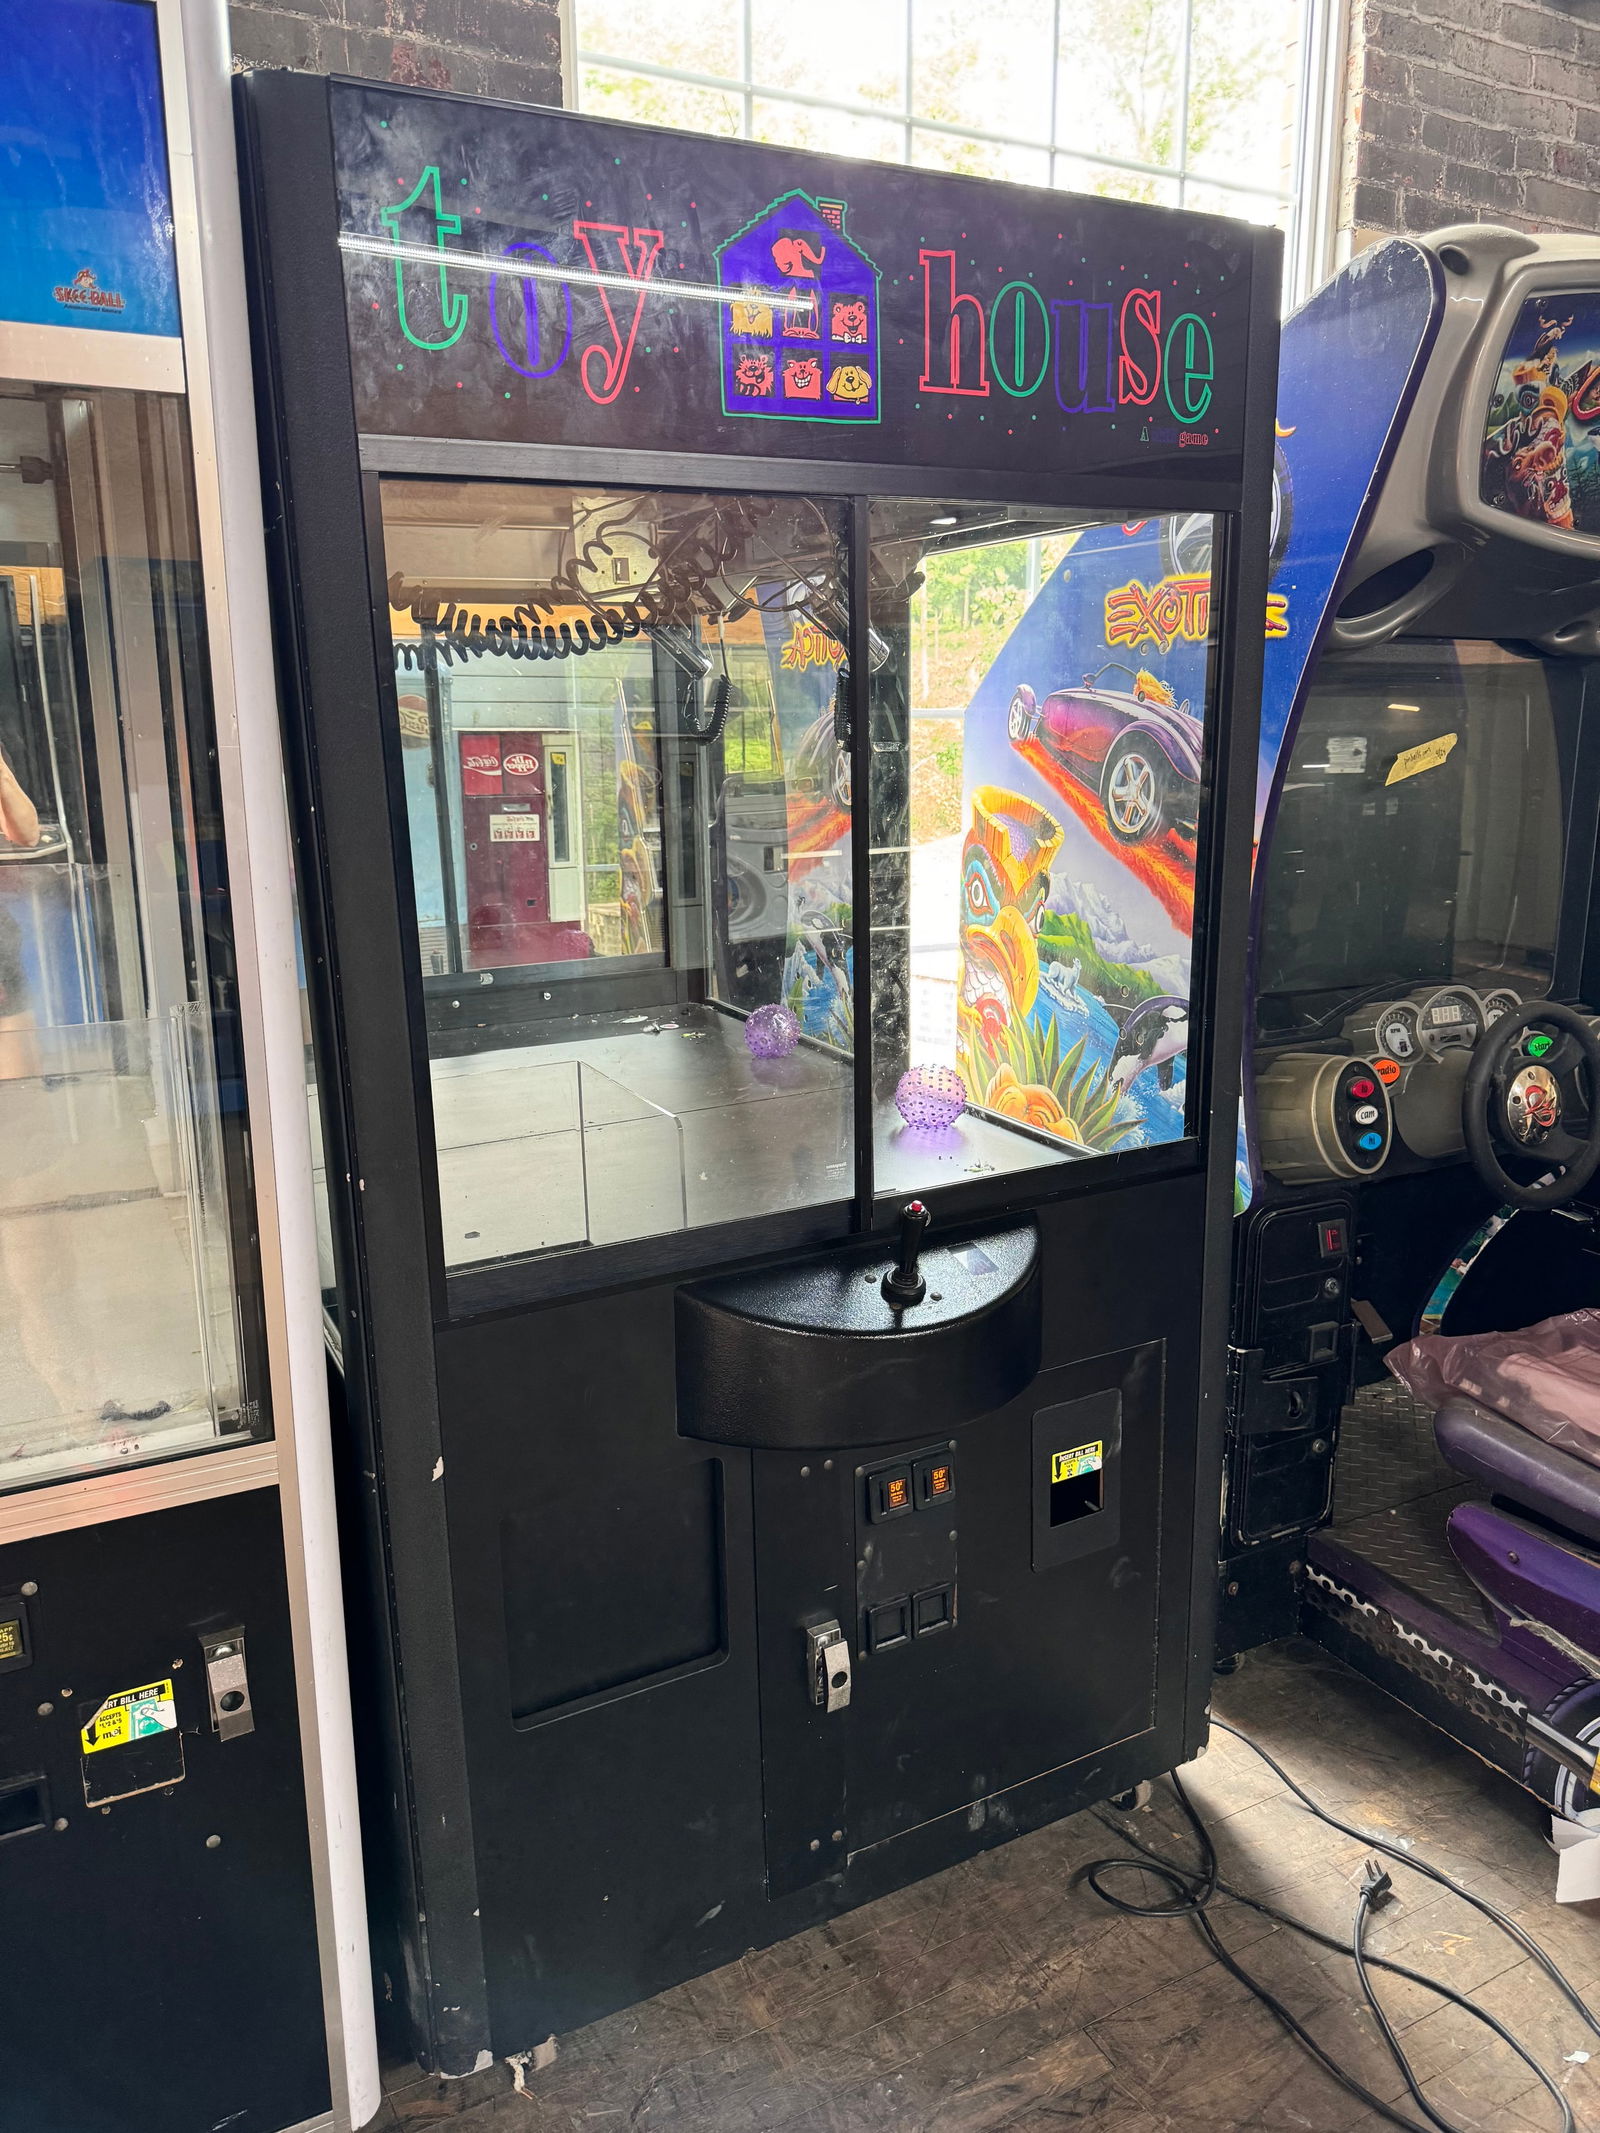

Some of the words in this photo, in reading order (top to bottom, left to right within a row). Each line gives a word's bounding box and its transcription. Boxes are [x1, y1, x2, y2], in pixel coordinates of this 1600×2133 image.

[54, 287, 124, 309] SKEE-BALL
[380, 165, 664, 405] toy
[918, 249, 1215, 424] house
[1140, 426, 1149, 442] A
[1179, 432, 1209, 447] game
[1108, 580, 1288, 645] EXOTI
[1377, 1065, 1397, 1075] radio
[1360, 1110, 1376, 1120] cam
[120, 1694, 137, 1705] BILL
[139, 1687, 159, 1699] HERE
[99, 1711, 122, 1722] ACCEPTS
